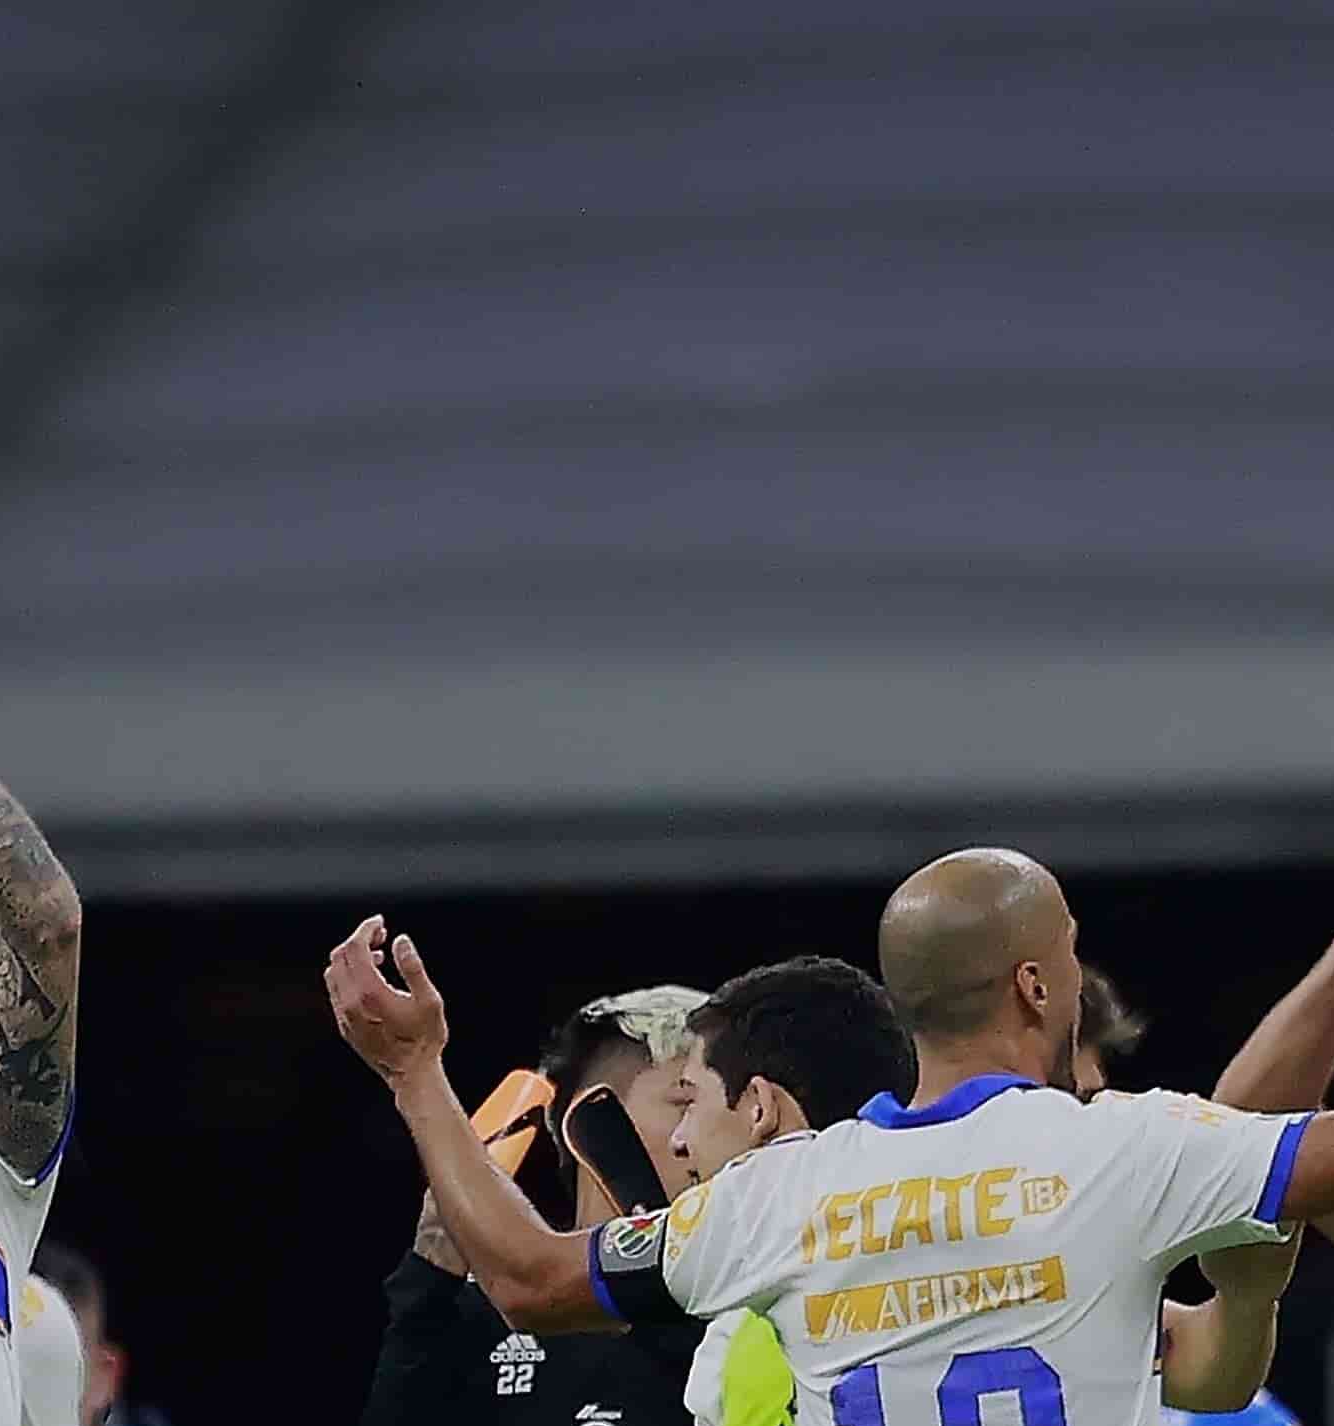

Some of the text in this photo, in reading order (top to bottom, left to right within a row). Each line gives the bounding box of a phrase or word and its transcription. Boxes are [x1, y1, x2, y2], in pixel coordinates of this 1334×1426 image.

[878, 1266, 1045, 1328] AFIRME
[490, 1350, 545, 1362] adidas
[497, 1364, 535, 1394] 22
